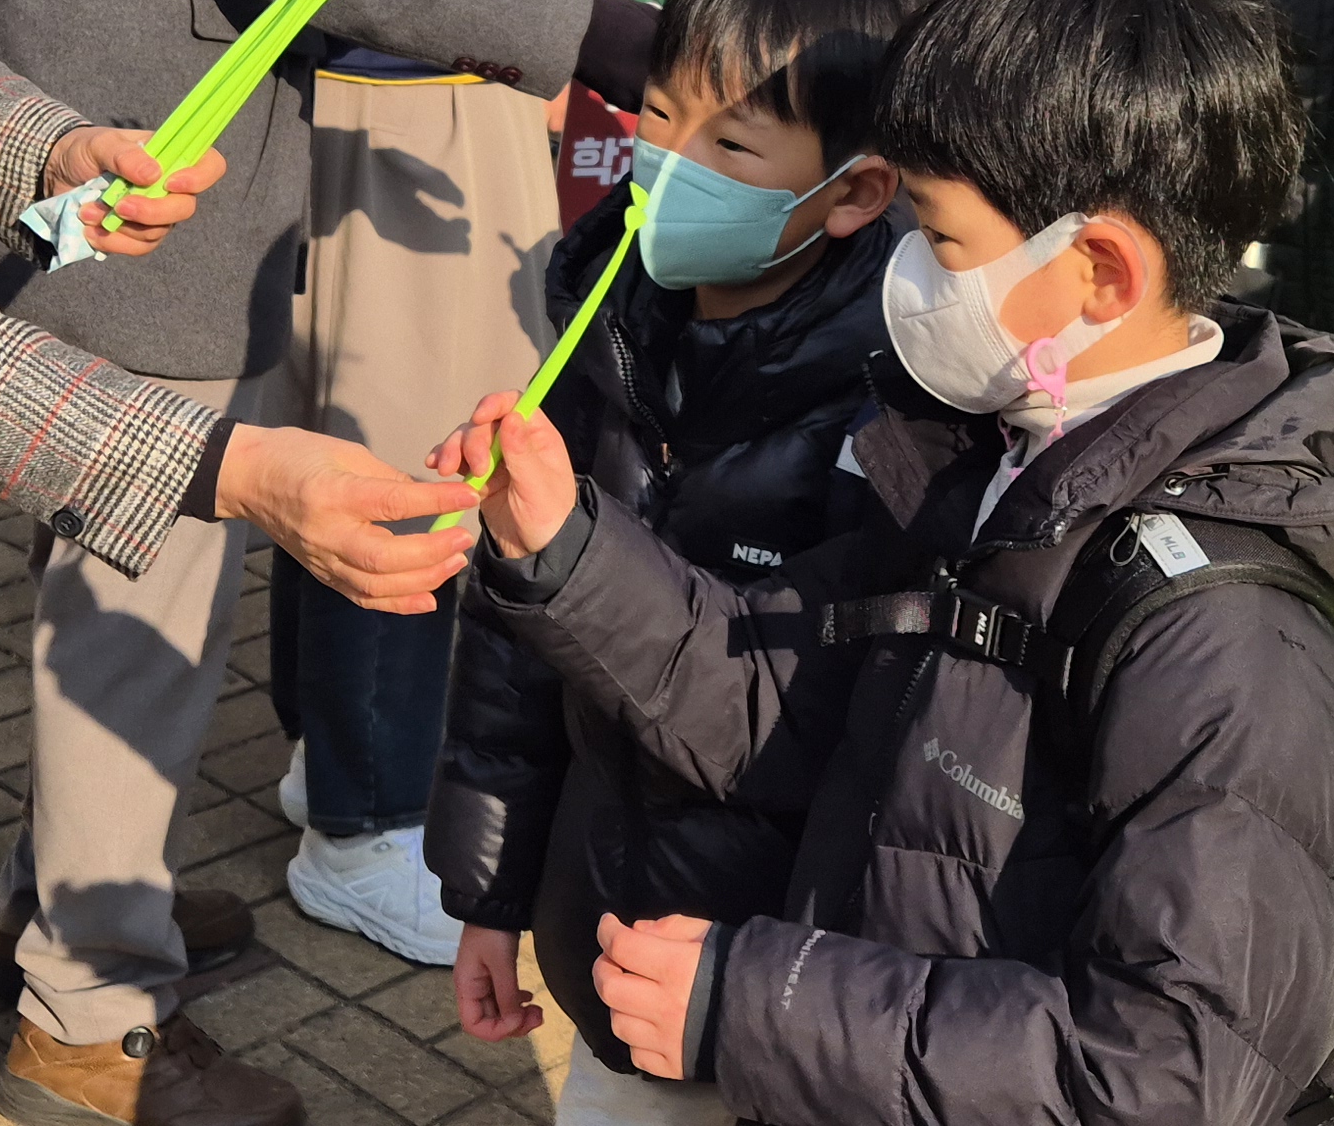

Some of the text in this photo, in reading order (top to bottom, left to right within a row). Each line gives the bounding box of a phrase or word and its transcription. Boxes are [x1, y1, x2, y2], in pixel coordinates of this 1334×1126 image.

[732, 542, 783, 567] NEPA
[1160, 535, 1186, 560] MLB
[939, 750, 1026, 820] Columbia
